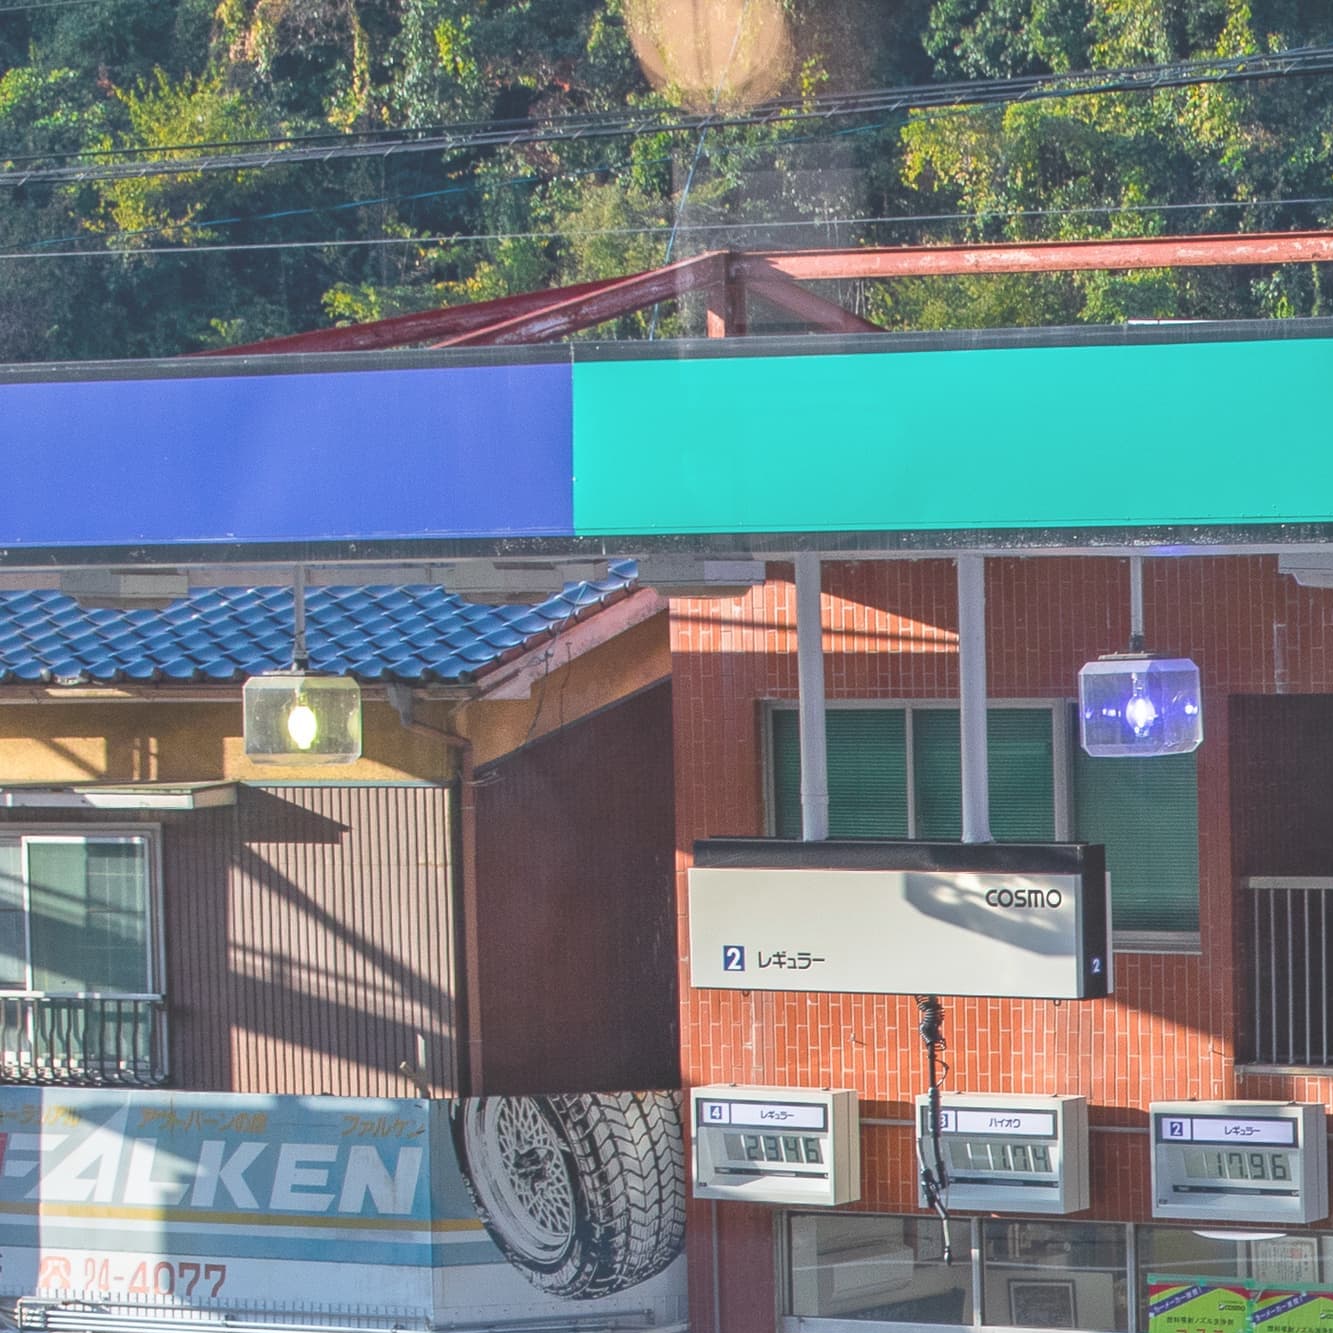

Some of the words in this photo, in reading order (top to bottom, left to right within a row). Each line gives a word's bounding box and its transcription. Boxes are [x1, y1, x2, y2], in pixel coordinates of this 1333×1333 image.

[985, 888, 1063, 909] COSMO
[727, 947, 743, 970] 2
[758, 951, 825, 970] レギュラー
[711, 1107, 721, 1120] 4
[760, 1111, 795, 1121] レギュラー
[988, 1117, 1021, 1129] ハイオク
[1172, 1122, 1182, 1136] 2
[1224, 1125, 1261, 1136] レギュラー
[4, 1110, 423, 1215] FALKEN
